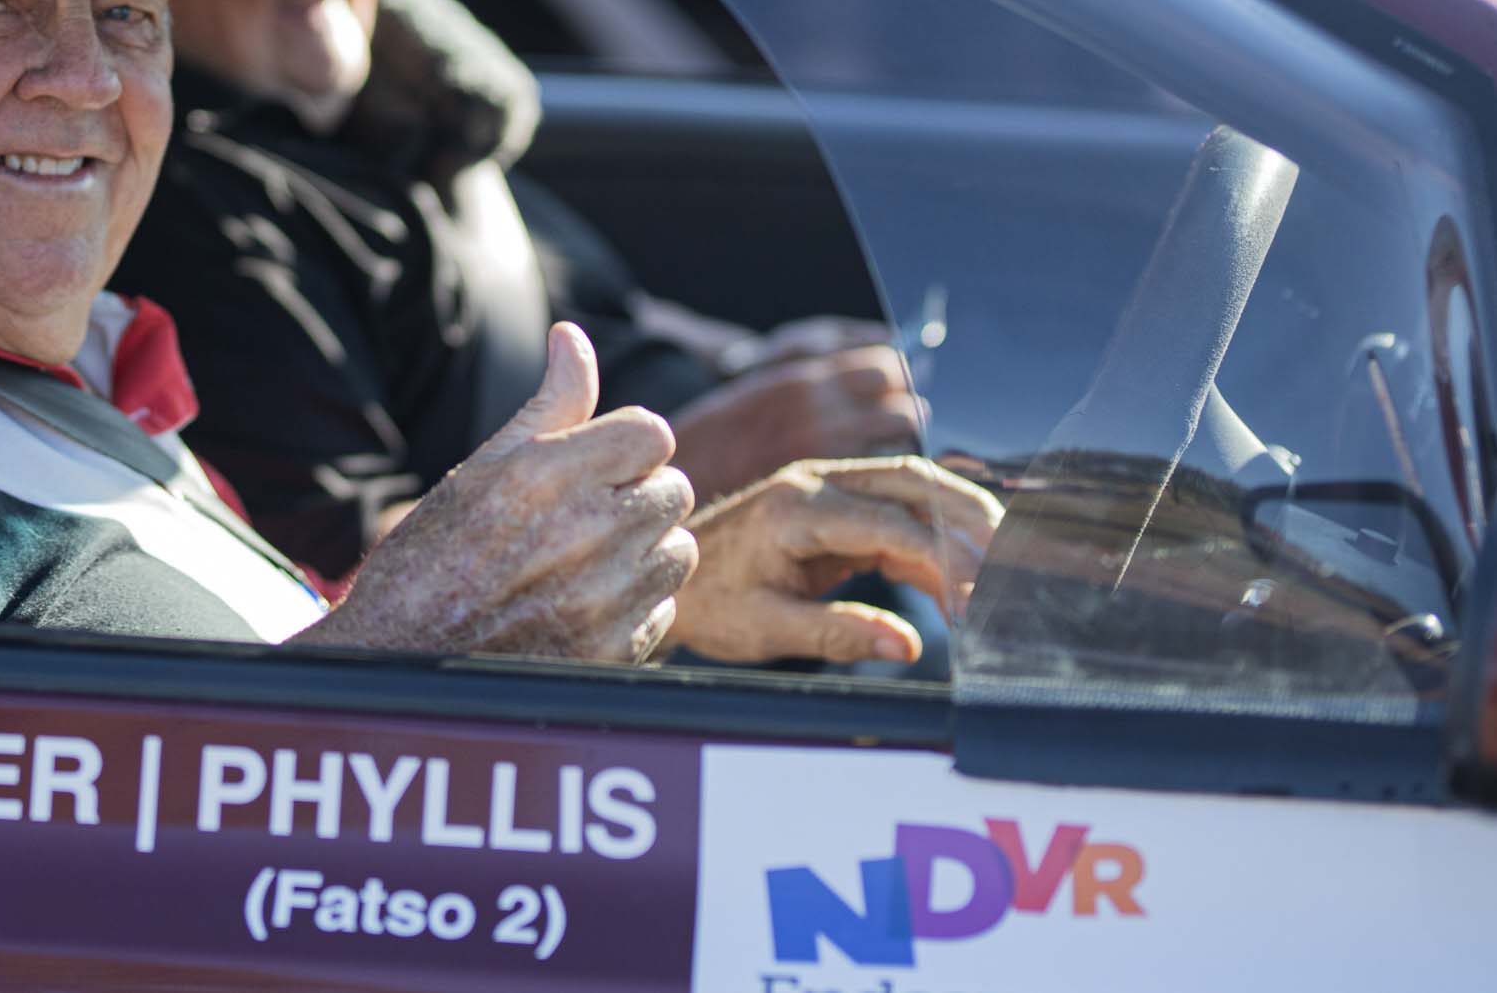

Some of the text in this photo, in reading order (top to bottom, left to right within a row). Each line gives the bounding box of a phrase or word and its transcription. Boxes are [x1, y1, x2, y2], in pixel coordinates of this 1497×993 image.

[197, 743, 657, 860] PHYLLIS
[243, 866, 568, 961] (Fatso 2)
[764, 817, 1148, 968] NDVR
